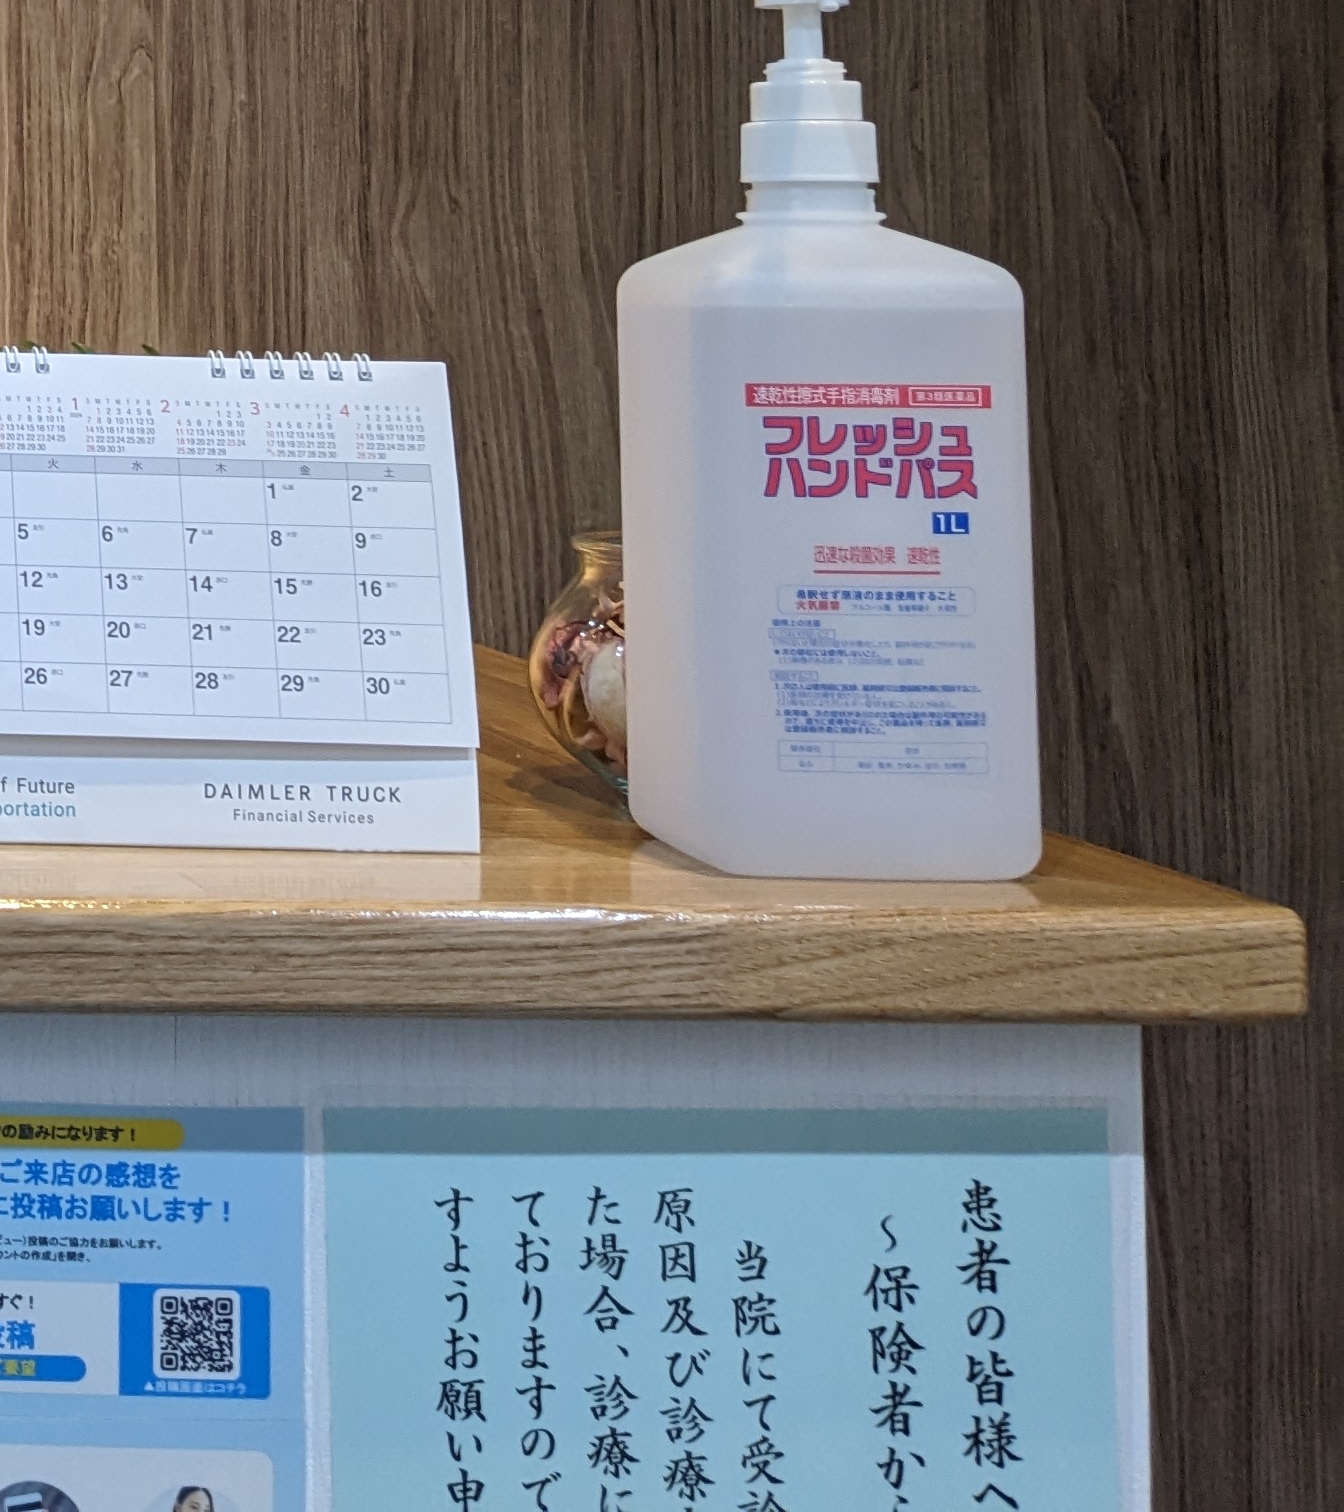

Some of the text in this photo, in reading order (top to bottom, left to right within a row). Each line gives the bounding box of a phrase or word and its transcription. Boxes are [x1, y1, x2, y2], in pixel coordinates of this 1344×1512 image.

[72, 398, 78, 410] 1
[160, 400, 170, 413] 2
[250, 402, 260, 415] 3
[340, 404, 350, 417] 4
[763, 416, 972, 456] フレッシュ
[47, 458, 59, 469] 火
[132, 461, 143, 471] 水
[216, 463, 227, 473] 木
[384, 467, 395, 478] 土
[764, 458, 978, 499] ハンドパス
[266, 484, 363, 502] 1 2
[937, 514, 965, 532] 1L
[17, 523, 30, 540] 5
[101, 525, 113, 542] 6
[185, 528, 198, 544] 7
[270, 530, 283, 547] 8
[354, 532, 367, 549] 9
[19, 571, 44, 588] 12
[104, 574, 129, 590] 13
[189, 576, 214, 593] 14
[273, 578, 298, 595] 15
[358, 580, 383, 597] 16
[22, 619, 46, 636] 19
[106, 621, 131, 639] 20
[191, 624, 214, 641] 21
[276, 626, 302, 643] 22
[362, 629, 386, 646] 23
[23, 667, 48, 685] 26
[109, 670, 134, 687] 27
[194, 672, 219, 690] 28
[280, 675, 304, 692] 29
[366, 677, 390, 694] 30
[16, 778, 75, 795] Future
[204, 783, 402, 804] DAIMLER TRUCK
[232, 808, 374, 825] Financial Services
[434, 1187, 487, 1509] すようお願い申
[512, 1189, 556, 1510] ておりますので
[654, 1187, 714, 1512] 原因及び診療
[958, 1178, 1022, 1507] 患者の皆様へ
